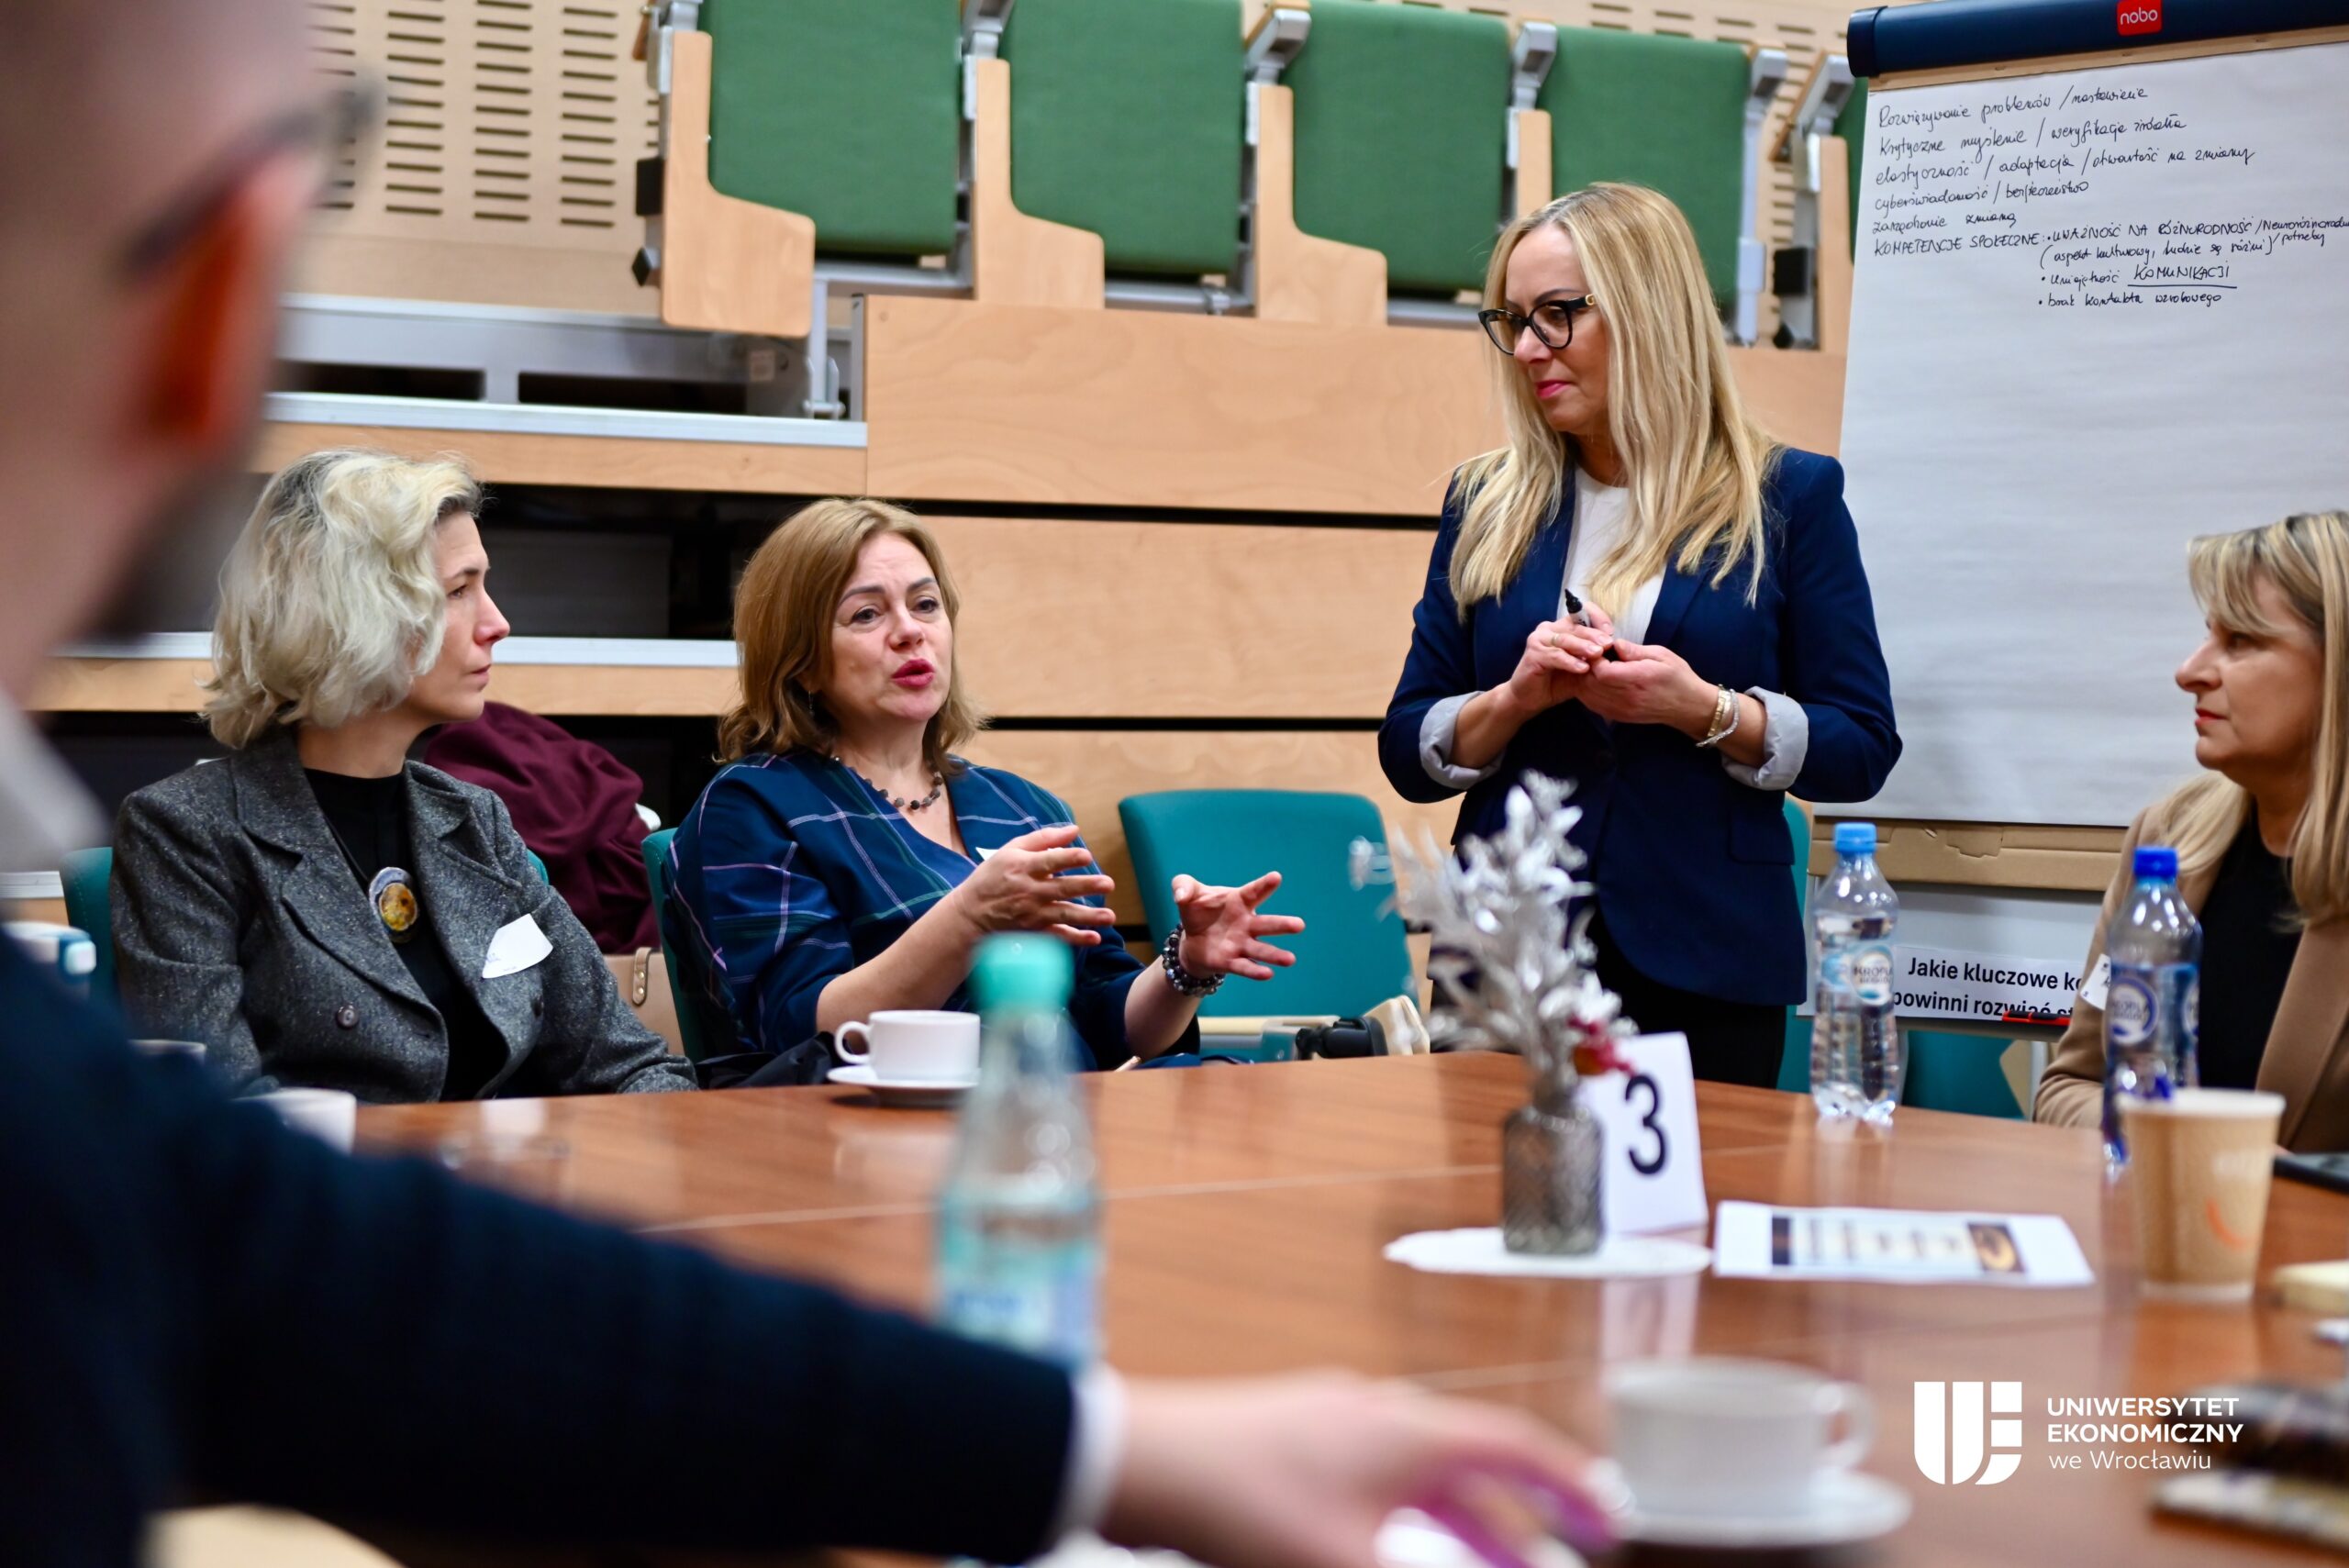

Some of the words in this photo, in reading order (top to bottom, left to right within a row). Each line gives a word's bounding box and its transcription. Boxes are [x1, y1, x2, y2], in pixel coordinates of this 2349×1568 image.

[2120, 6, 2158, 26] nobo
[1981, 94, 2051, 123] problemów
[2195, 147, 2256, 166] zmiany
[1874, 237, 1963, 257] KOMPETENCJE
[2128, 224, 2149, 238] NA
[2133, 261, 2230, 281] KOMUNIKACJI
[2048, 293, 2075, 307] brak
[1908, 957, 1958, 979] Jakie
[1963, 962, 2058, 989] kluczowe
[1624, 1073, 1666, 1176] 3
